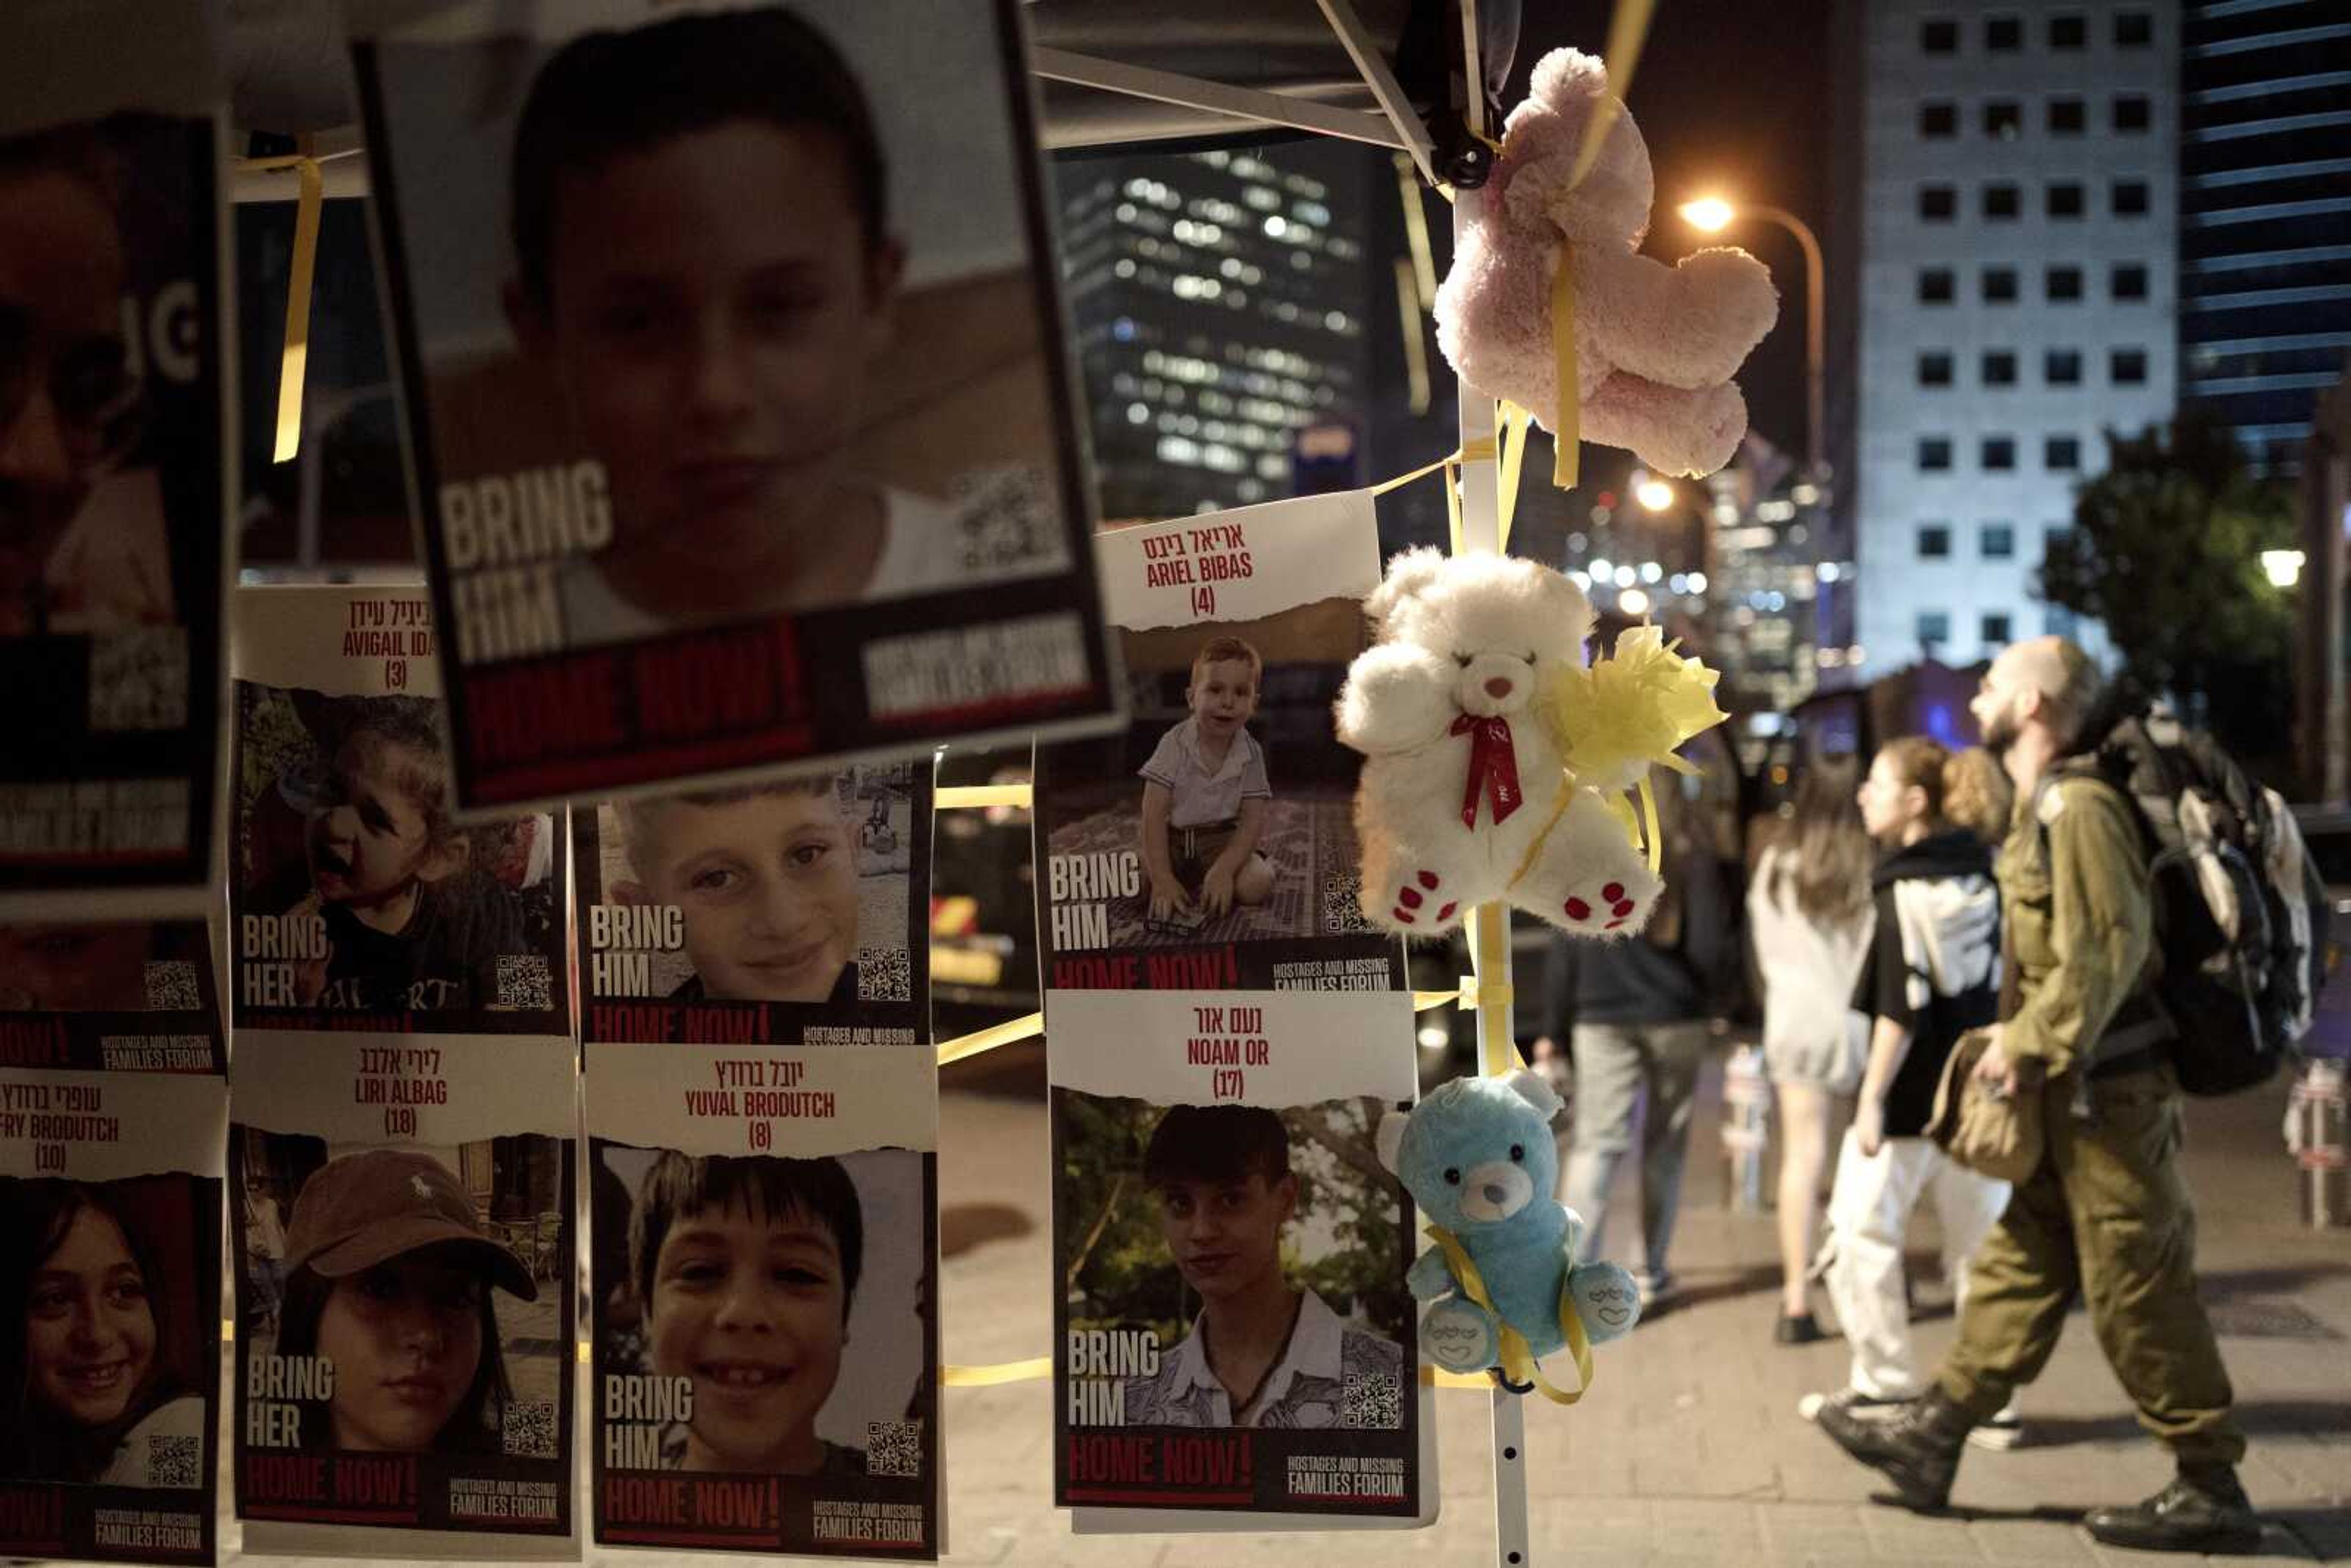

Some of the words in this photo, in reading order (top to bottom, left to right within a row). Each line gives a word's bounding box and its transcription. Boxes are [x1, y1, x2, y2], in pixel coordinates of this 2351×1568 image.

[440, 460, 612, 569] BRING
[1142, 533, 1185, 559] ביבס
[1187, 523, 1245, 553] אריאל
[1147, 559, 1196, 588] ARIEL
[1199, 552, 1252, 582] BIBAS
[350, 600, 384, 629] עידן
[391, 599, 433, 626] ביגיל
[1192, 585, 1215, 617] (4)
[343, 632, 406, 656] AVIGAIL
[411, 632, 436, 656] IDA
[386, 659, 407, 689] (3)
[1049, 852, 1140, 902] BRING
[243, 914, 328, 960] BRING
[589, 905, 684, 950] BRING
[1051, 903, 1109, 951] HIM
[590, 952, 651, 999] HIM
[1053, 955, 1138, 988] HOME
[1146, 942, 1237, 988] NOW!
[1273, 962, 1322, 978] HOSTAGES
[1324, 960, 1344, 976] AND
[1346, 958, 1389, 975] MISSING
[244, 963, 298, 1008] HER
[591, 1006, 675, 1043] HOME
[681, 1001, 773, 1043] NOW!
[1194, 1008, 1224, 1034] אור
[1230, 1008, 1262, 1034] נעם
[360, 1047, 401, 1075] אלבג
[408, 1047, 440, 1075] לירי
[1188, 1039, 1239, 1065] NOAM
[1246, 1039, 1269, 1065] OR
[715, 1060, 765, 1089] ברודץ
[770, 1060, 804, 1086] יובל
[1213, 1068, 1244, 1100] (17)
[2, 1083, 50, 1111] ברודץ
[54, 1086, 101, 1112] עופרי
[356, 1079, 386, 1104] LIRI
[392, 1080, 448, 1104] ALBAG
[685, 1091, 740, 1116] YUVAL
[744, 1092, 835, 1117] BRODUTCH
[31, 1114, 118, 1141] BRODUTCH
[385, 1107, 416, 1137] (18)
[749, 1120, 771, 1150] (8)
[36, 1142, 66, 1172] (10)
[1068, 1329, 1160, 1376] BRING
[246, 1354, 334, 1402] BRING
[604, 1375, 694, 1422] BRING
[1068, 1380, 1126, 1427] HIM
[246, 1403, 302, 1447] HER
[604, 1424, 661, 1469] HIM
[1069, 1435, 1153, 1483] HOME
[1162, 1433, 1253, 1485] NOW!
[1339, 1458, 1359, 1472] AND
[246, 1457, 327, 1501] HOME
[332, 1458, 421, 1506] NOW!
[1288, 1471, 1351, 1495] FAMILIES
[1354, 1472, 1404, 1497] FORUM
[451, 1494, 508, 1517] FAMILIES
[511, 1496, 557, 1519] FORUM
[605, 1477, 687, 1523] HOME
[694, 1477, 780, 1529] NOW!
[814, 1516, 872, 1540] FAMILIES
[876, 1518, 923, 1542] FORUM
